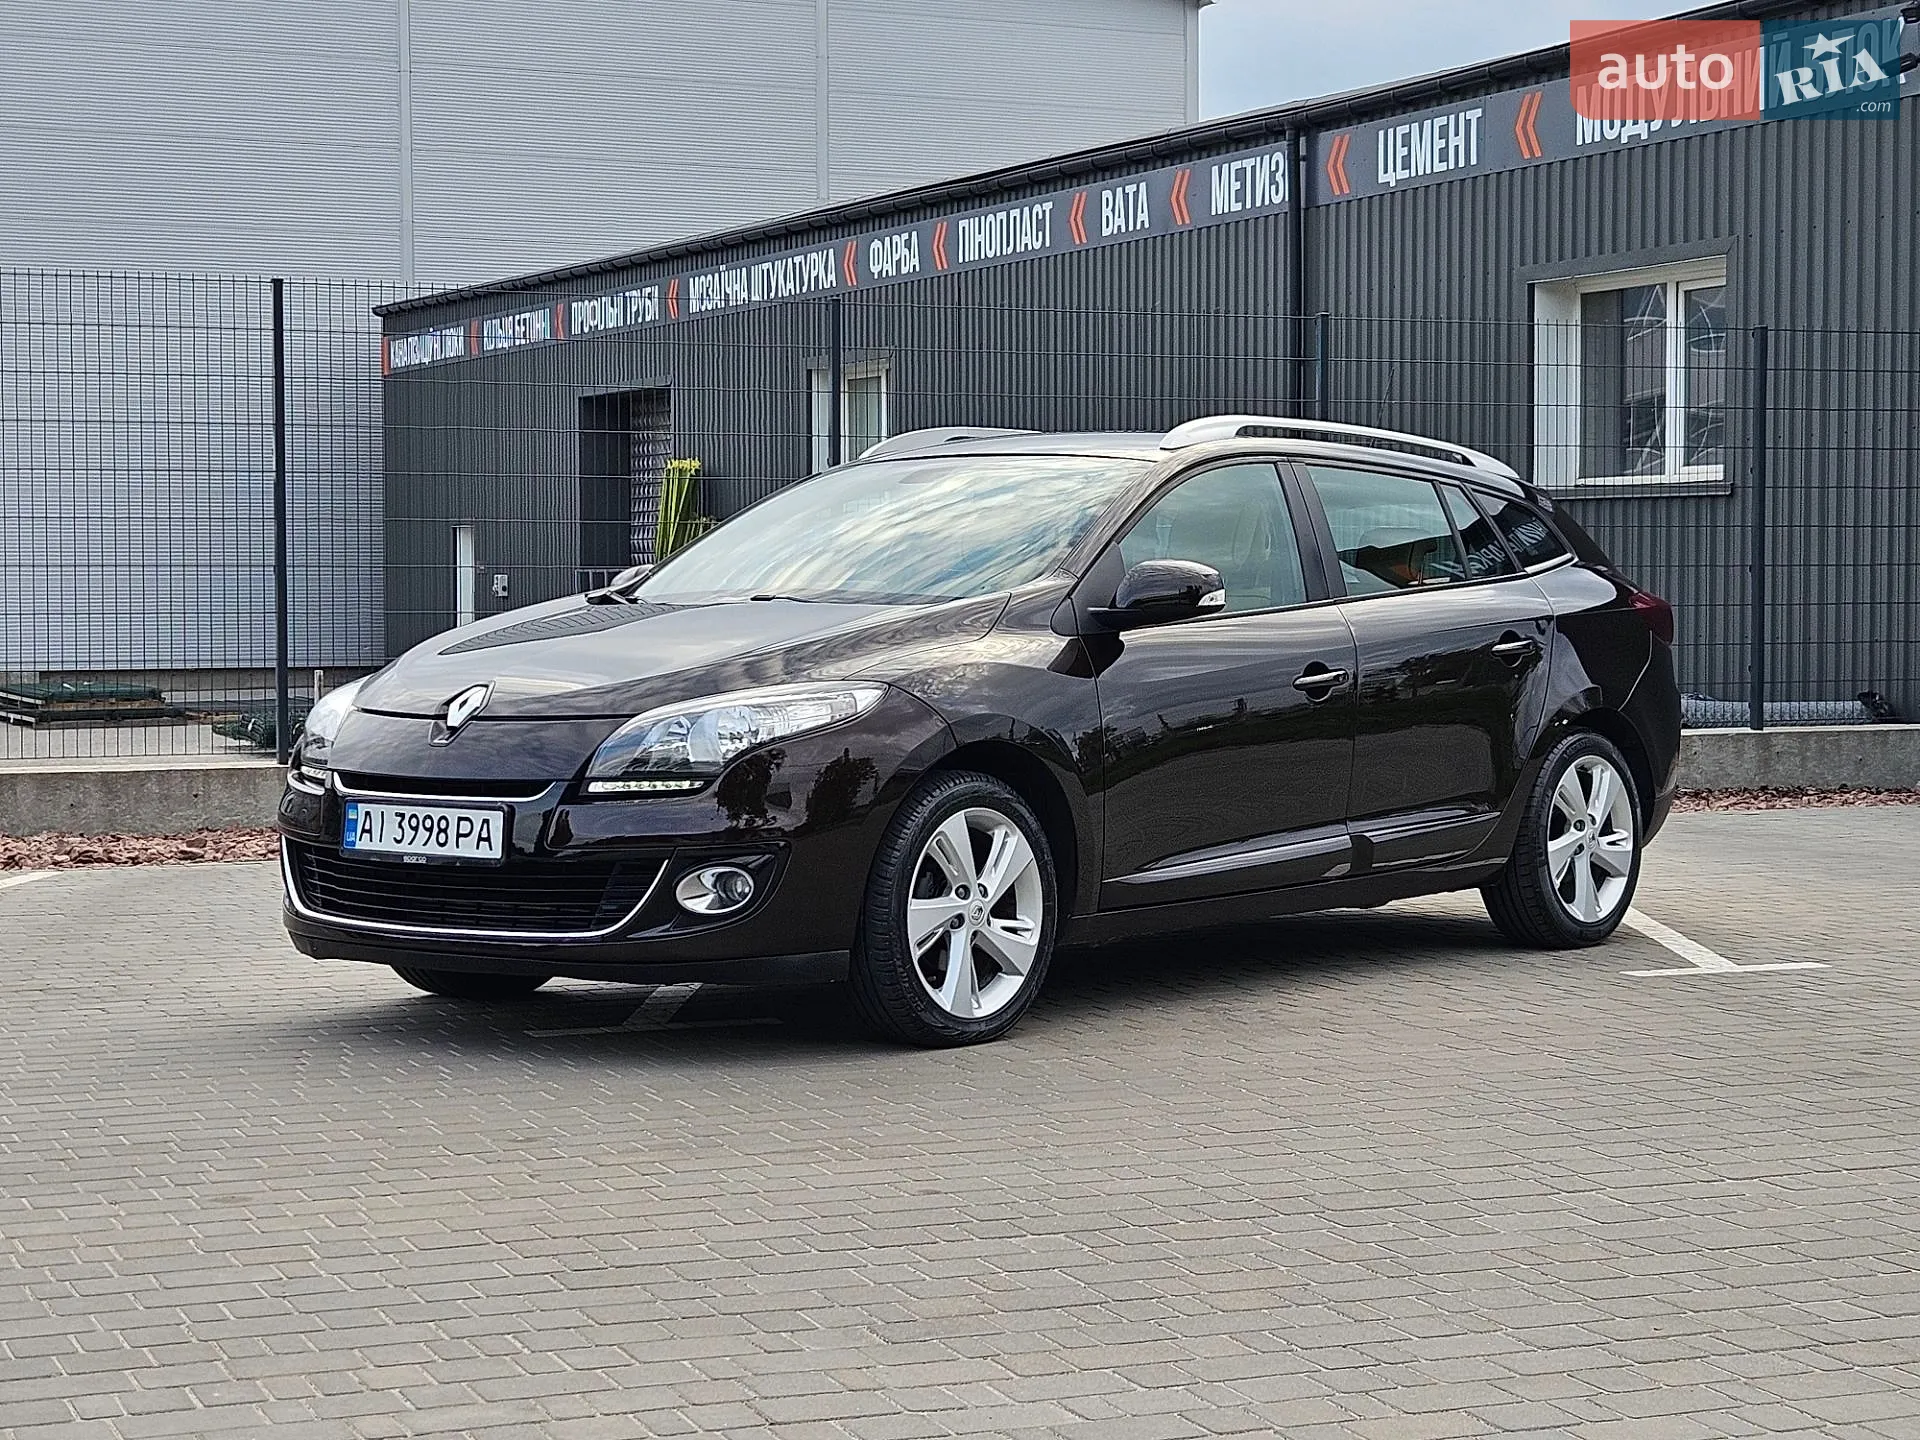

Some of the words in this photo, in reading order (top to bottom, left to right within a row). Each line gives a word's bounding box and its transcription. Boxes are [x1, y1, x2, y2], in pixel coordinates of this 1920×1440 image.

[1378, 108, 1482, 188] ЦЕМЕНТ
[1101, 181, 1150, 238] ВАТА
[1211, 149, 1289, 216] МЕТИЗ
[869, 230, 921, 280] ФАРБА
[958, 202, 1053, 264] ПІНОПЛАСТ
[624, 285, 659, 326] ТРУБИ
[689, 264, 749, 314] МОЗАЇЧНА
[750, 248, 837, 302] ШТУКАТУРКА
[358, 810, 385, 843] AI
[392, 811, 450, 848] 3998
[455, 816, 494, 852] PA
